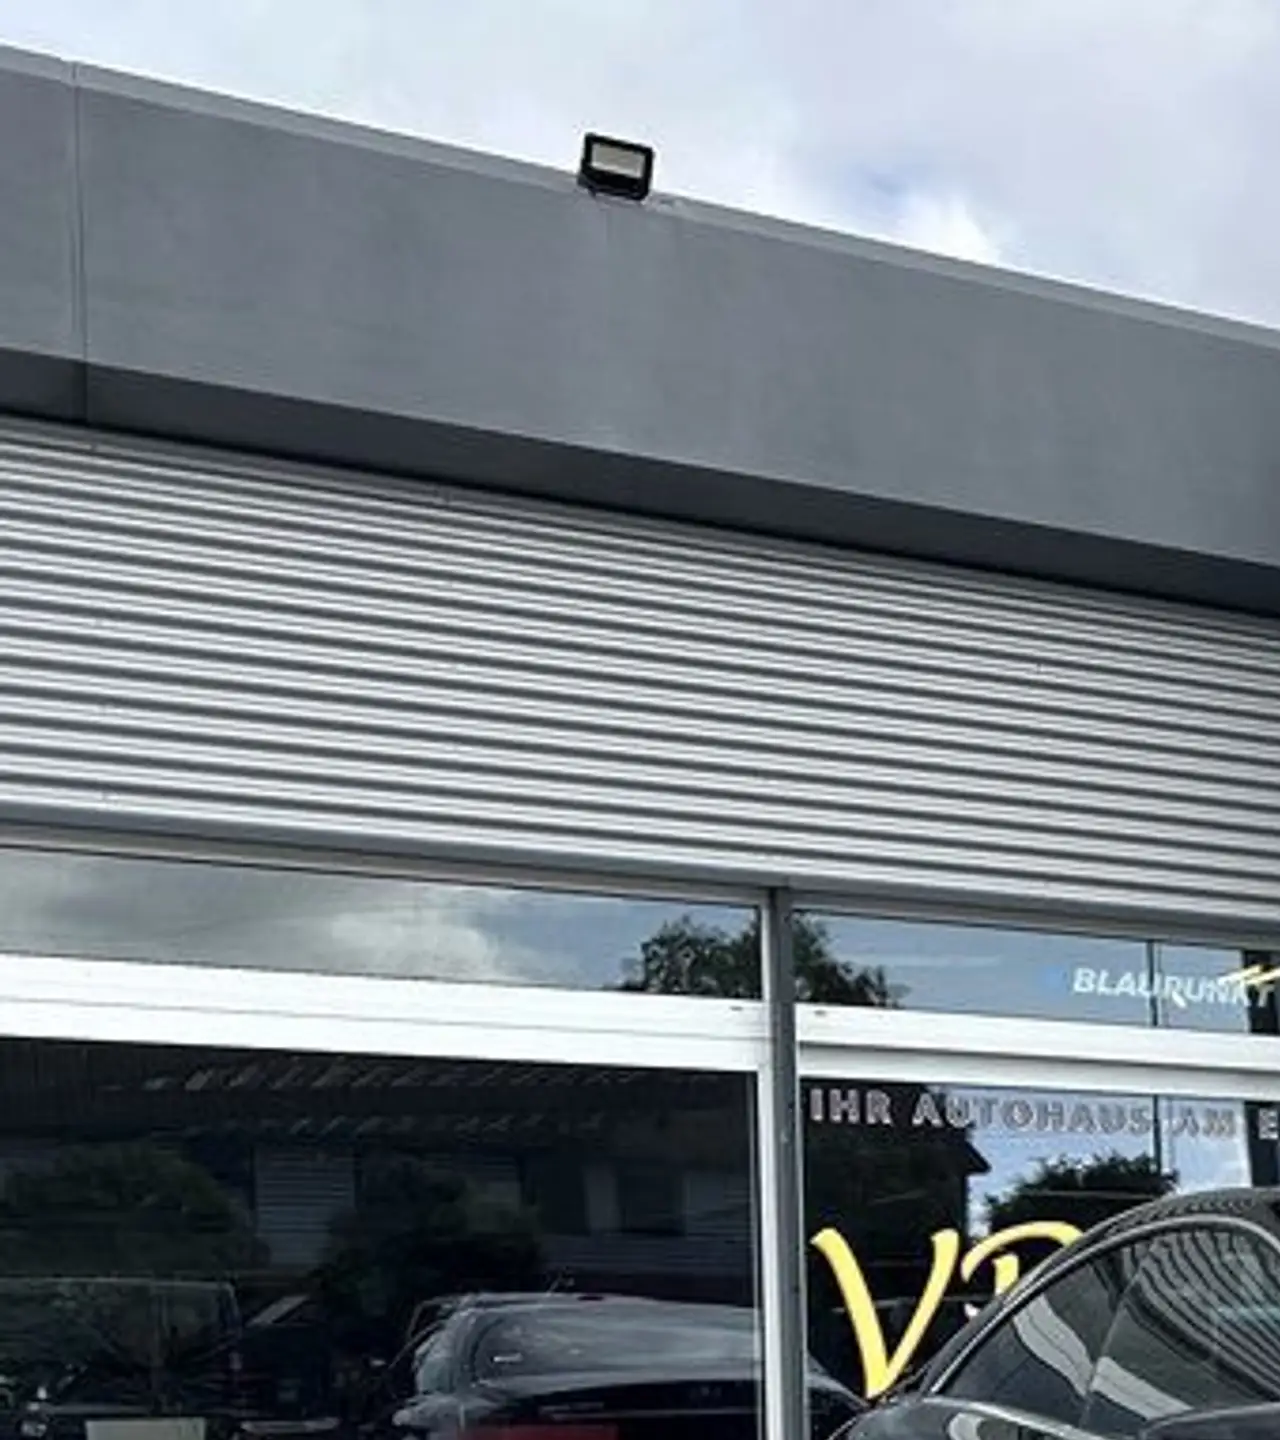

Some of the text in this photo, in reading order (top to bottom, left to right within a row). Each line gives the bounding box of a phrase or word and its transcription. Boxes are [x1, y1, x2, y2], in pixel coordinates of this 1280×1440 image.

[808, 1088, 891, 1127] IHR
[911, 1092, 1150, 1136] AUTOHAUS
[1171, 1105, 1237, 1137] AM
